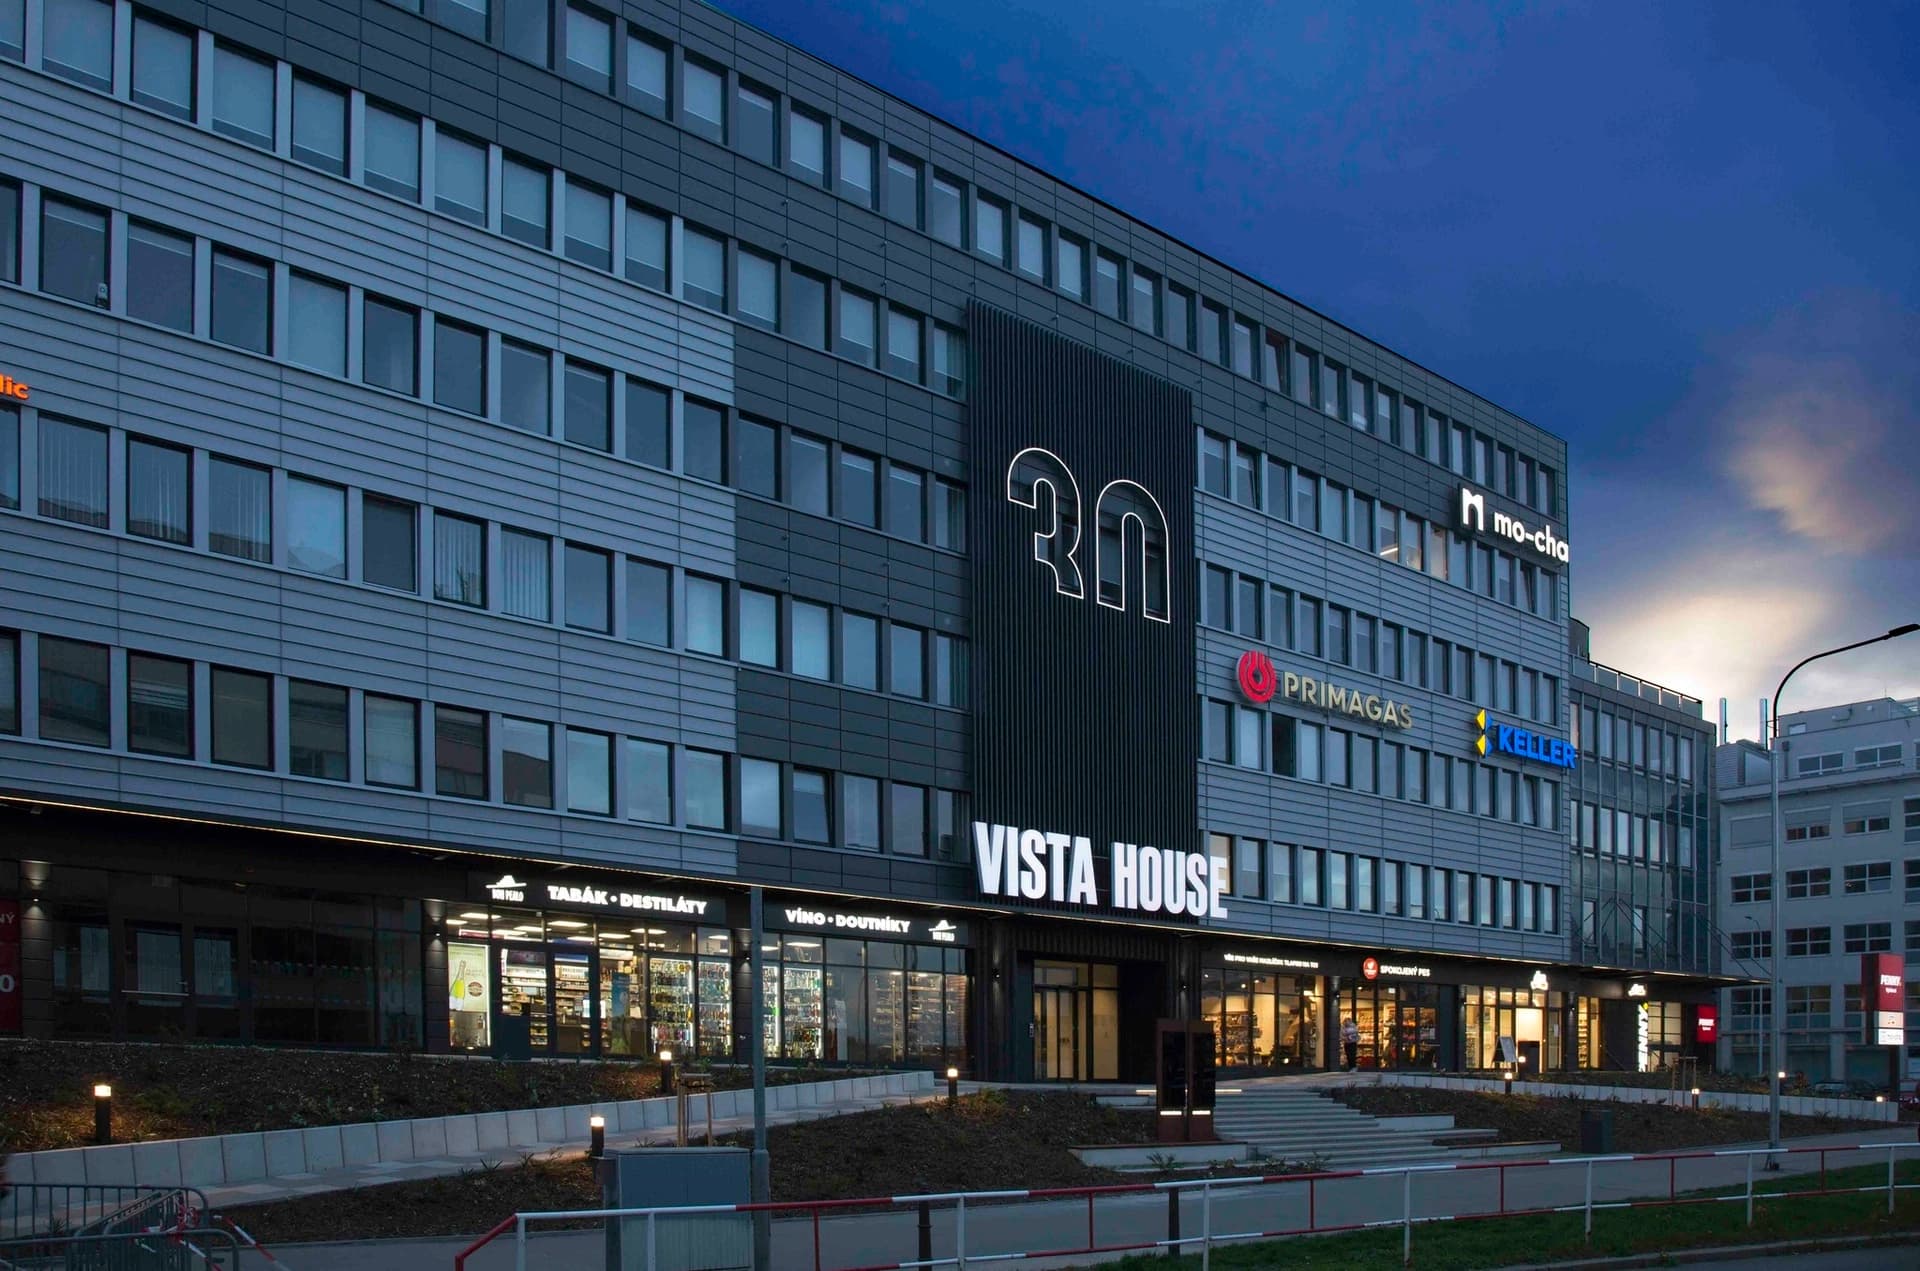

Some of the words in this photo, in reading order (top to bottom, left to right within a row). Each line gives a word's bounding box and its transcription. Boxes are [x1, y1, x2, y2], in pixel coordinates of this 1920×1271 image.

[1494, 511, 1569, 563] mo-cha
[1284, 670, 1413, 729] PRIMAGAS
[1498, 724, 1576, 769] KELLER
[972, 821, 1098, 906] VISTA
[1112, 842, 1228, 919] HOUSE
[547, 886, 609, 906] TABÁK
[619, 893, 708, 915] DESTILÁTY
[784, 907, 826, 926] VÍNO
[835, 915, 911, 934] DOUTNÍKY
